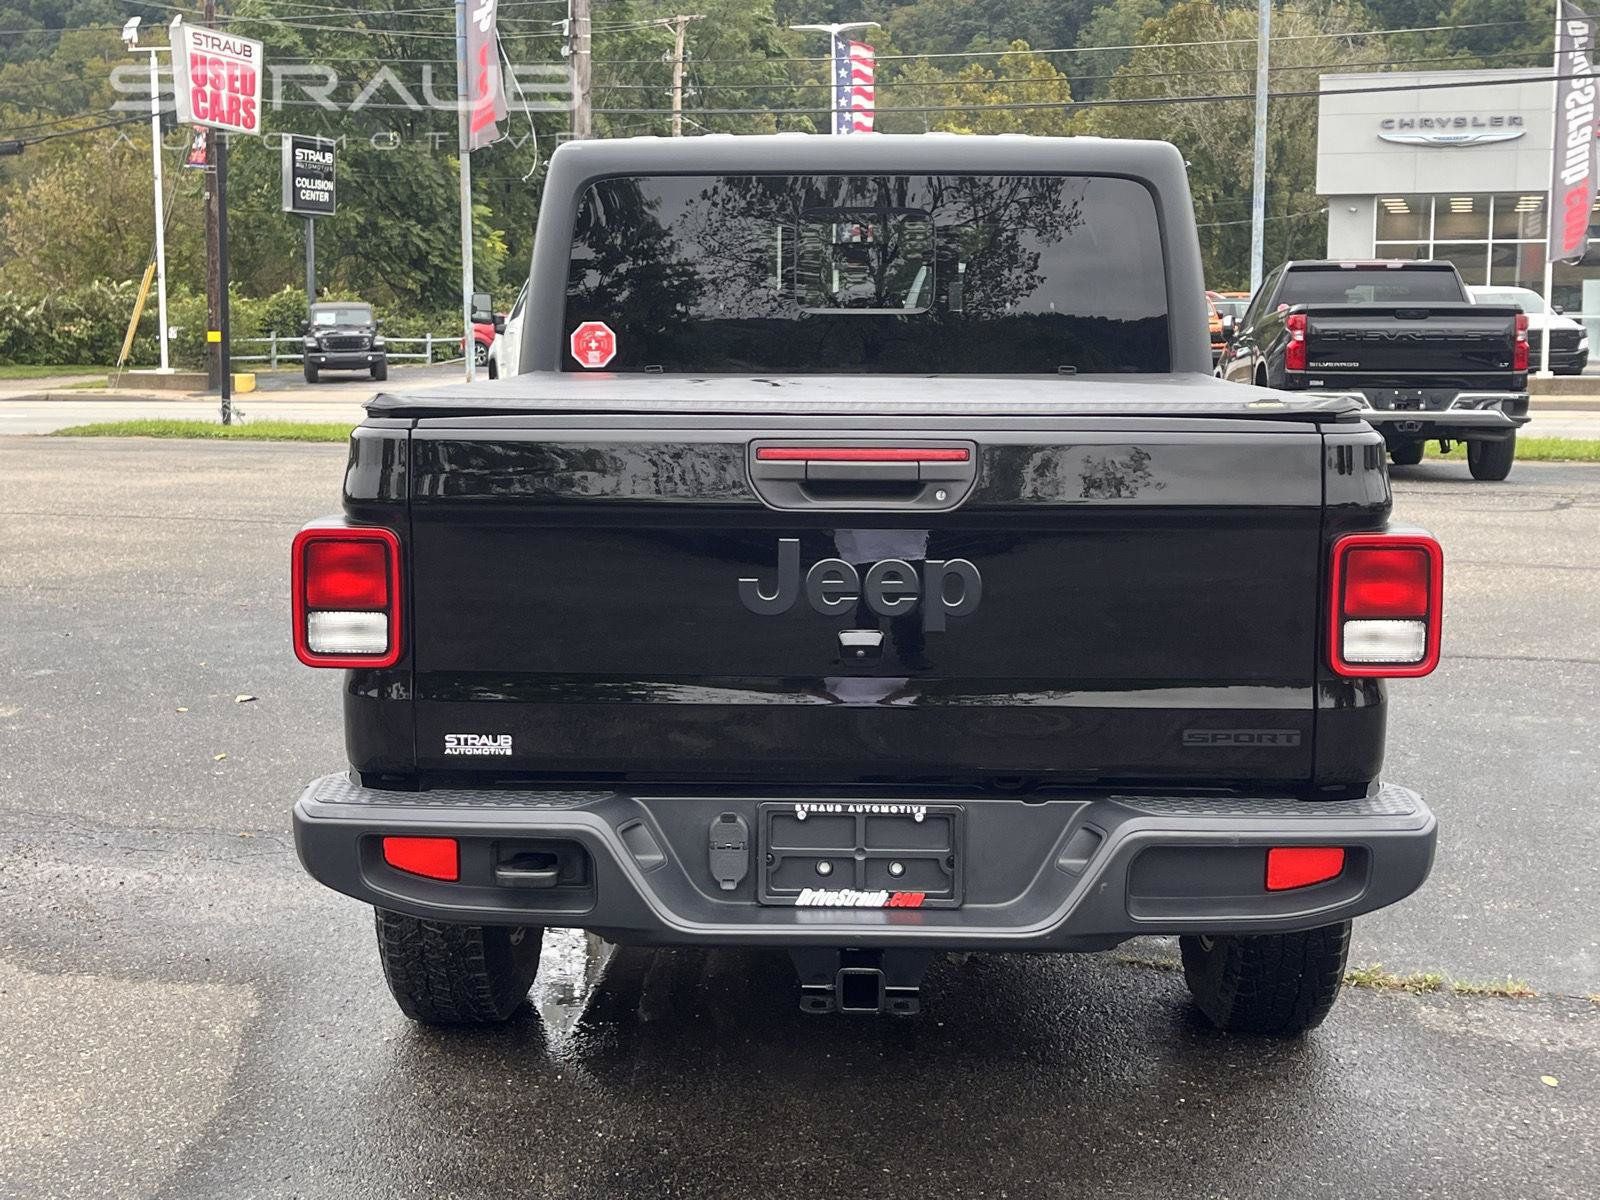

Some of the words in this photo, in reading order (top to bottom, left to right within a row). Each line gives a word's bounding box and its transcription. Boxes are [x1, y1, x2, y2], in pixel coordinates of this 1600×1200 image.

[192, 32, 253, 58] STRAUB
[190, 53, 256, 97] USED
[191, 87, 256, 130] CARS
[1380, 116, 1524, 130] CHRYSLER
[295, 148, 334, 164] STRAUB
[295, 177, 334, 191] COLLISION
[300, 189, 330, 202] CENTER
[1320, 329, 1502, 341] CHEVROLET
[738, 538, 982, 632] Jeep
[444, 734, 513, 746] STRAUB
[1184, 731, 1300, 744] SPORT
[795, 804, 842, 813] STRAUB
[848, 804, 927, 814] AUTOMOTIVE
[795, 888, 926, 907] DriveStraub.com
